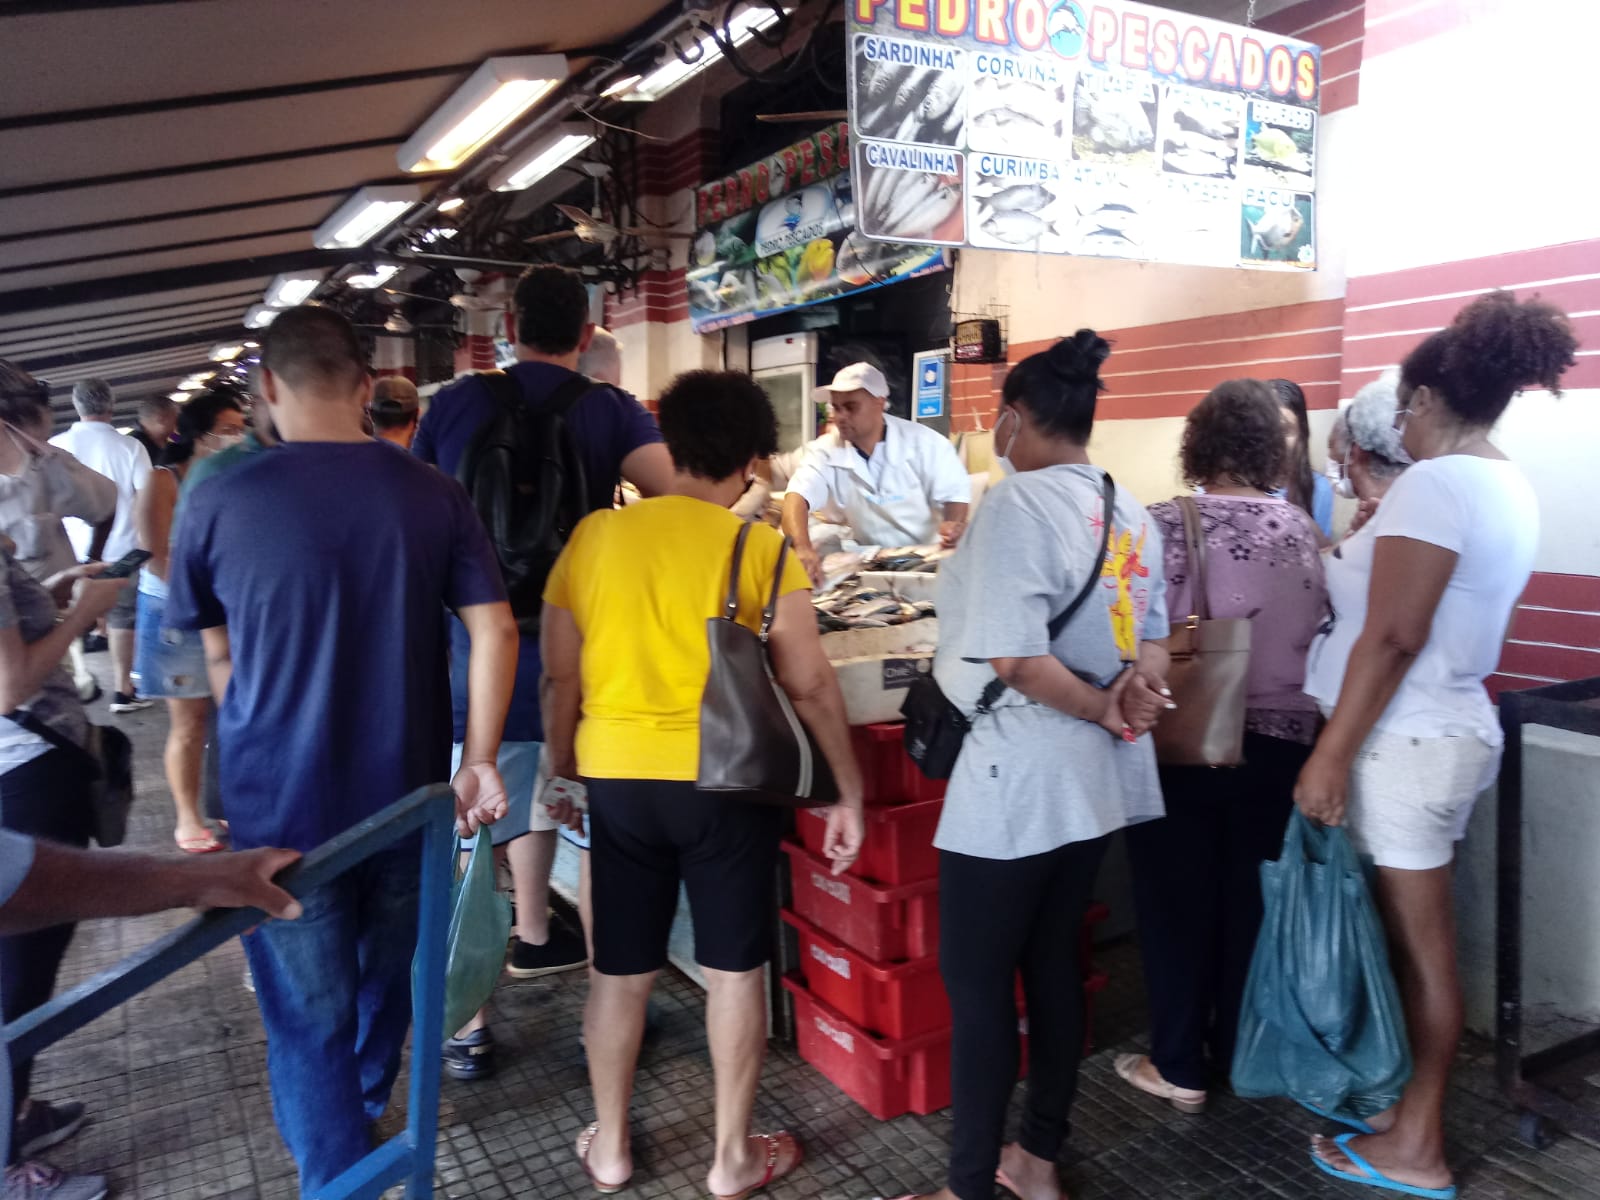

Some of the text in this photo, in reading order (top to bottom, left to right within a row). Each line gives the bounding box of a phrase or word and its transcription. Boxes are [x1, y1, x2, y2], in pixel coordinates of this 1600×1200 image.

[866, 38, 955, 70] SARDINHA
[1087, 5, 1316, 100] PESCADOS
[976, 55, 1057, 83] CORVINA
[867, 144, 956, 173] CAVALINHA
[980, 155, 1060, 181] CURIMBA
[1246, 187, 1293, 208] PACU
